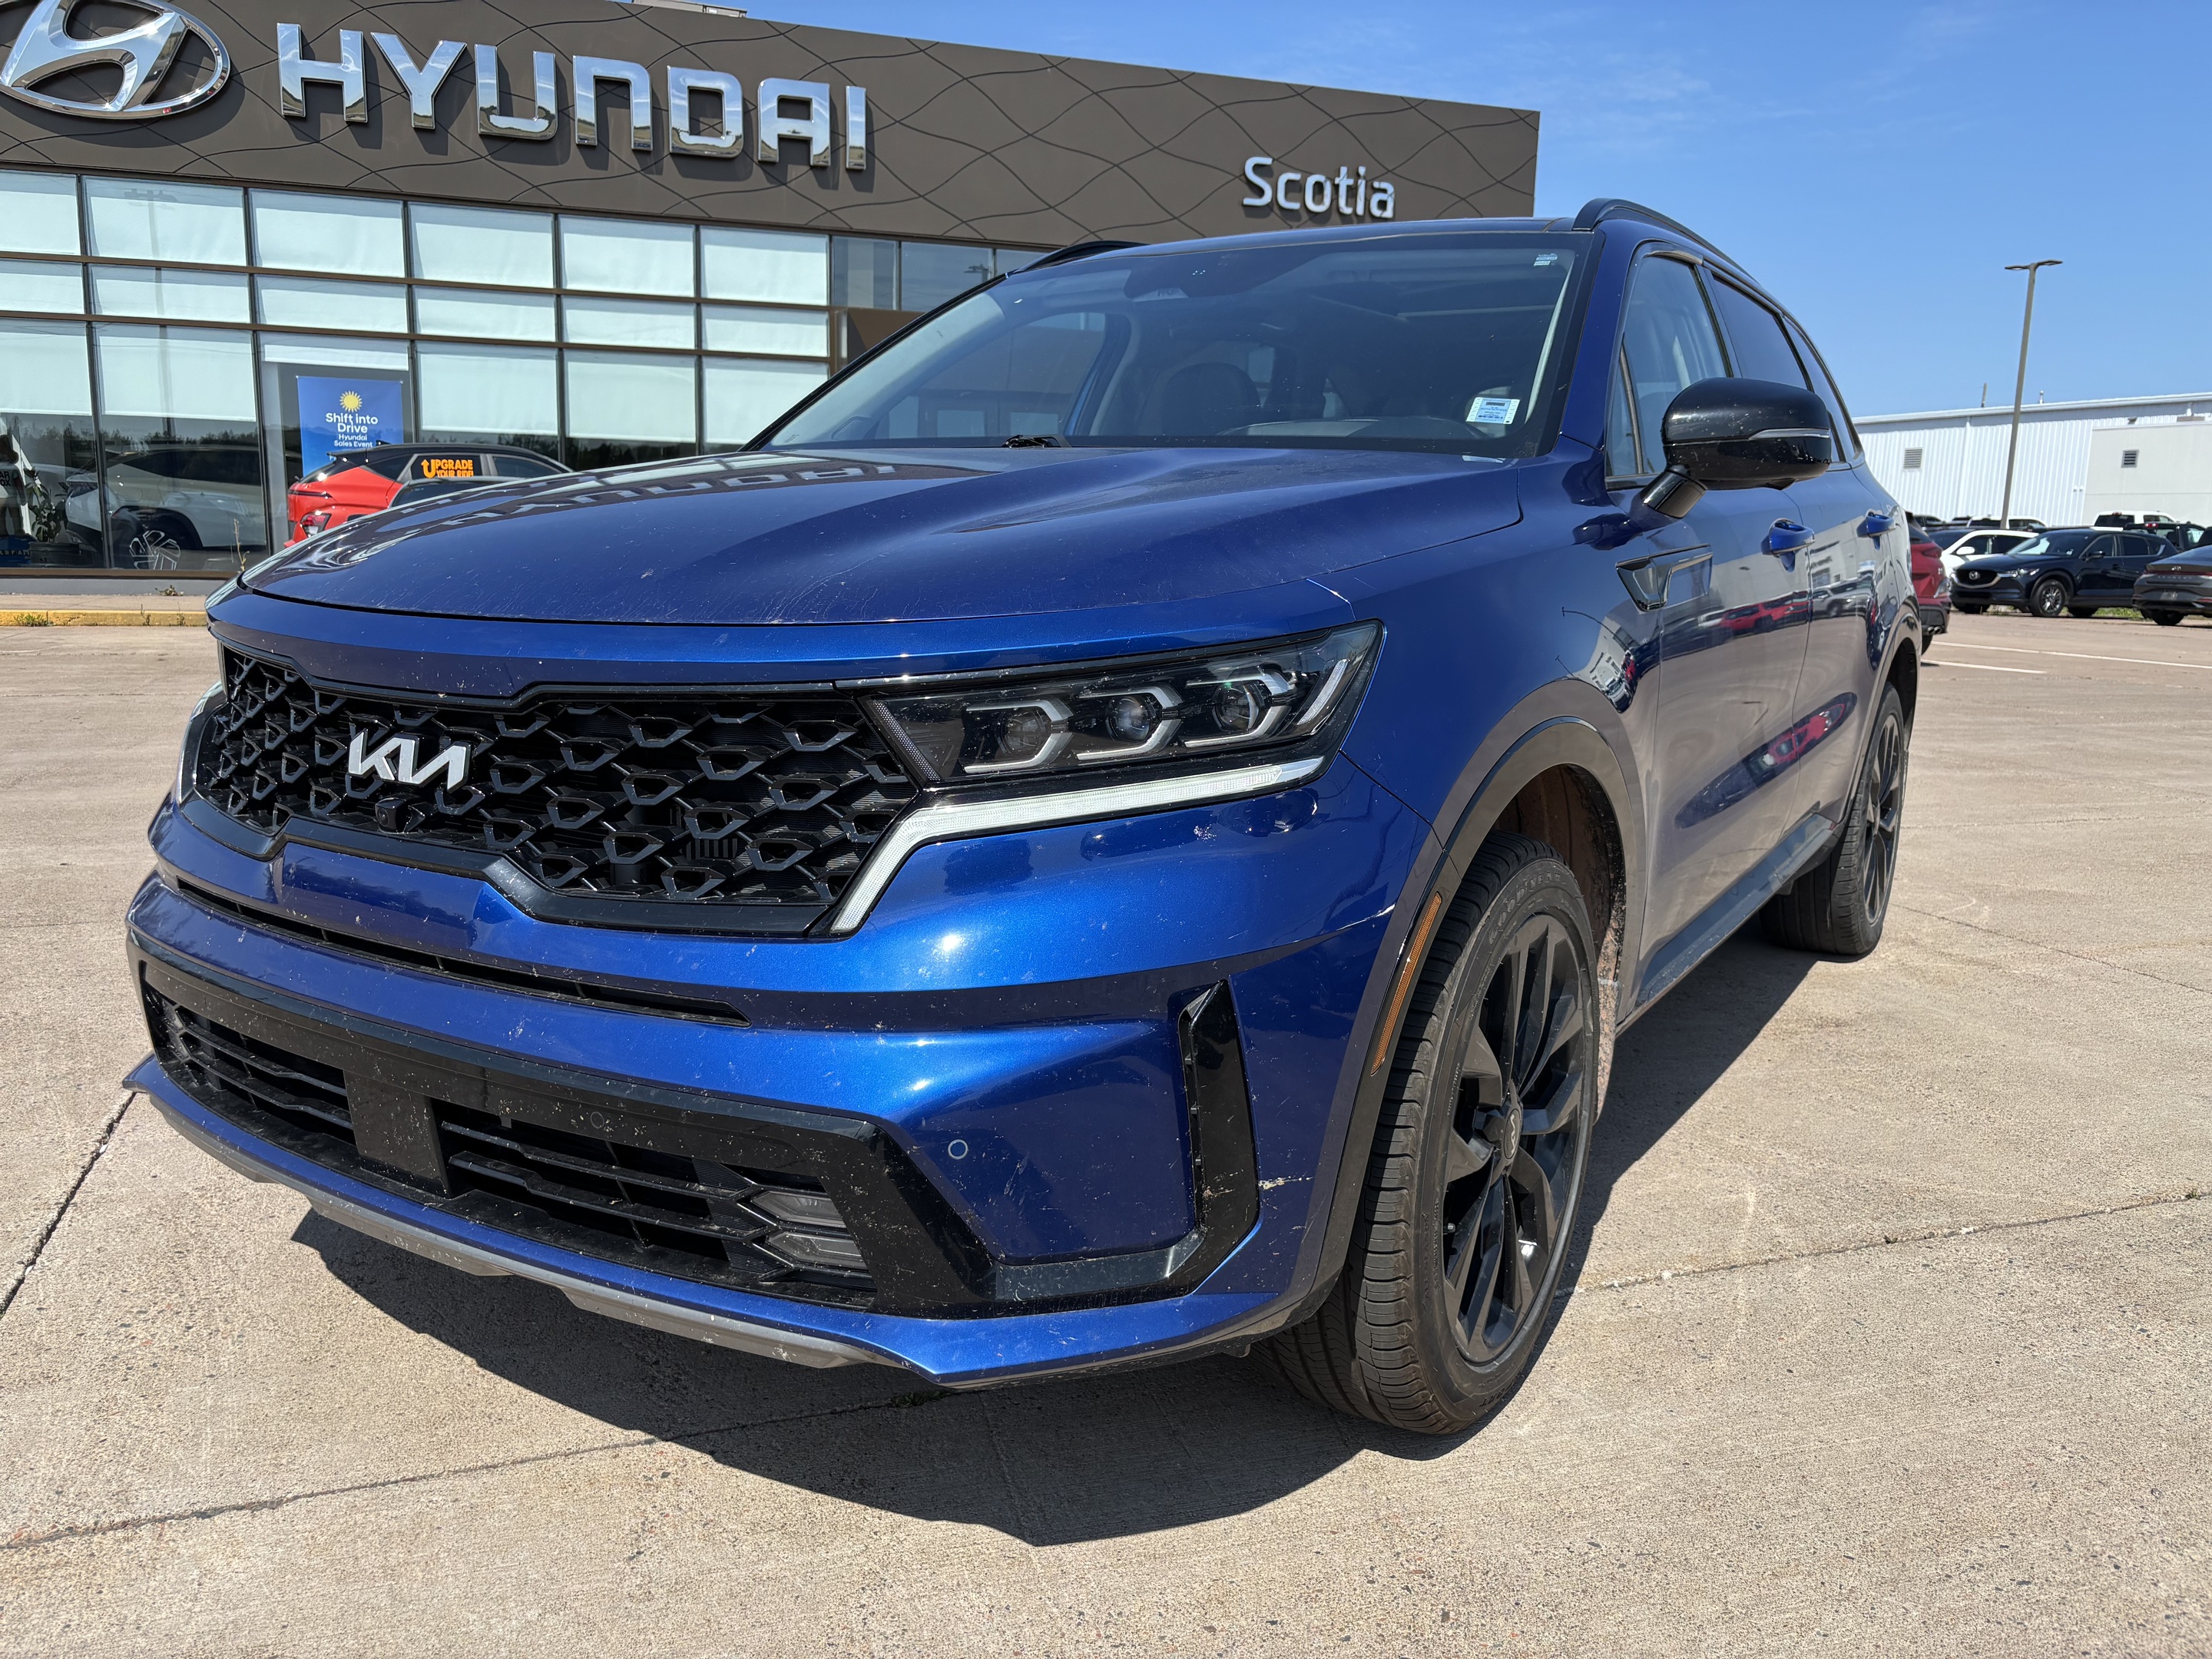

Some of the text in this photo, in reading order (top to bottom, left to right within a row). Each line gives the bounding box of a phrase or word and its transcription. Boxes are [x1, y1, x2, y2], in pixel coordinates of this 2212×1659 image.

[277, 22, 866, 171] HYUNDAI
[1241, 156, 1395, 218] Scotia
[326, 412, 379, 425] Shift into
[337, 423, 368, 433] Drive
[339, 434, 368, 442] Hyundai
[0, 471, 10, 479] AR
[421, 459, 473, 478] UPGRADE
[436, 469, 455, 478] YOUR
[348, 729, 471, 793] KIA
